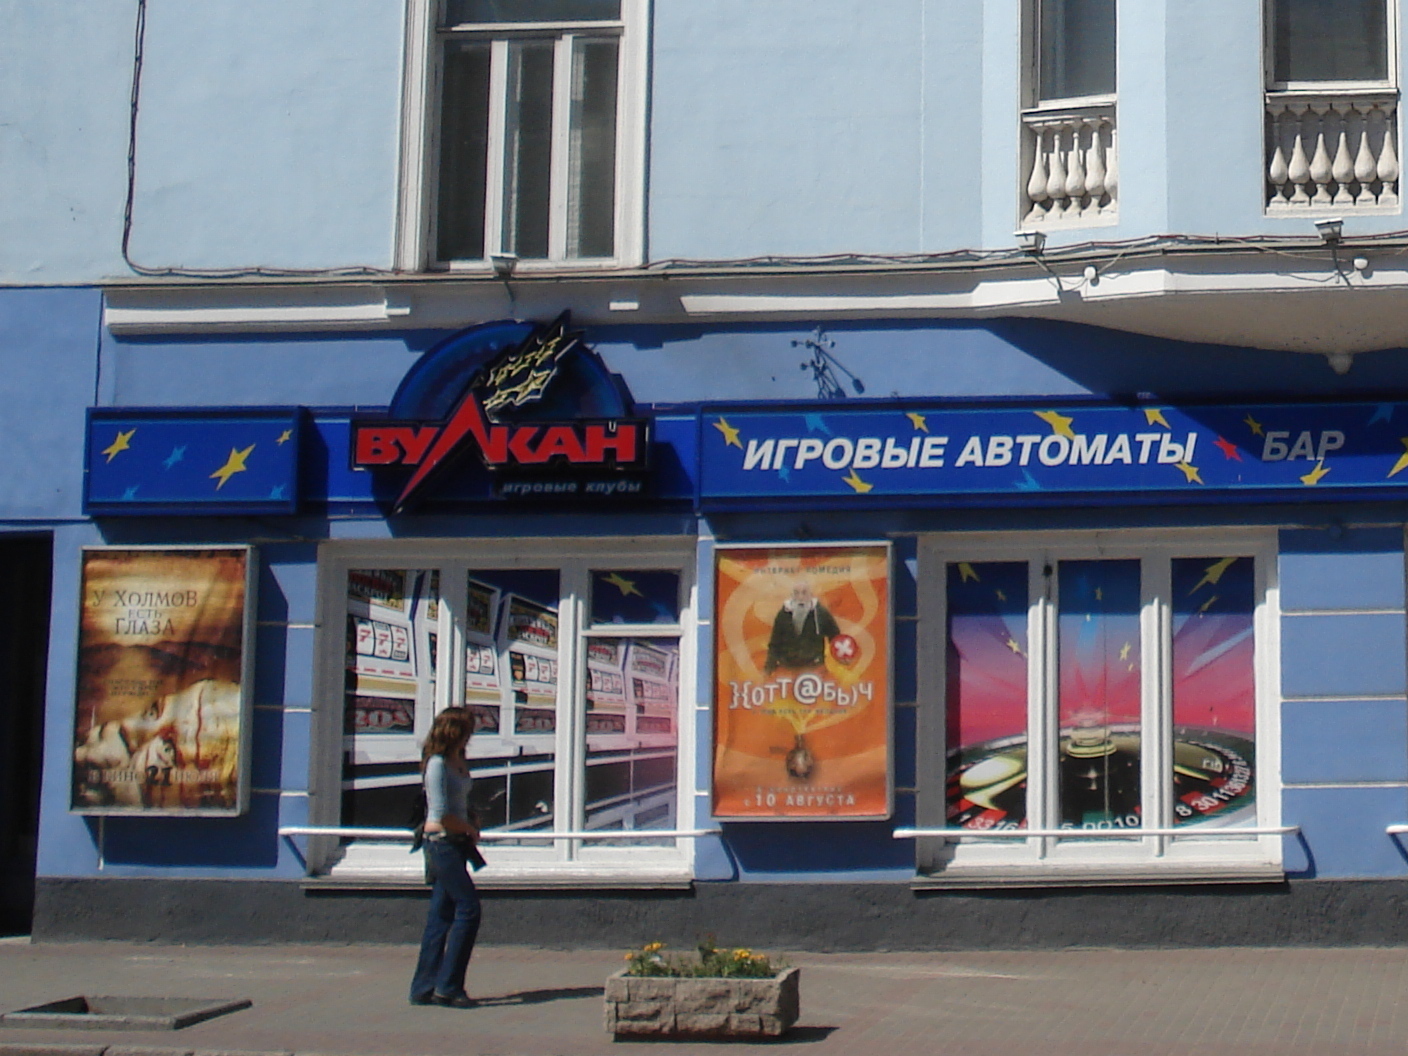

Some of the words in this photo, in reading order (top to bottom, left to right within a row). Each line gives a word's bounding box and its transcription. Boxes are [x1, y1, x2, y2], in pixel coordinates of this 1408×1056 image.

[355, 391, 637, 510] ВУЛКАН
[742, 436, 947, 471] ИГРОВЫЕ
[954, 432, 1198, 467] АВТОМАТЫ
[1261, 430, 1345, 462] БАР
[502, 480, 577, 494] игровые
[585, 480, 641, 493] клубы
[92, 590, 106, 607] У
[113, 590, 198, 607] ХОЛМОВ
[128, 608, 163, 619] ЕСТЬ
[115, 618, 175, 635] ГЛАЗА
[145, 765, 172, 786] 21
[756, 794, 776, 807] 10
[786, 794, 855, 808] АВГУСТА
[1190, 796, 1219, 811] 30
[1175, 805, 1192, 817] 8
[1114, 815, 1139, 828] 10
